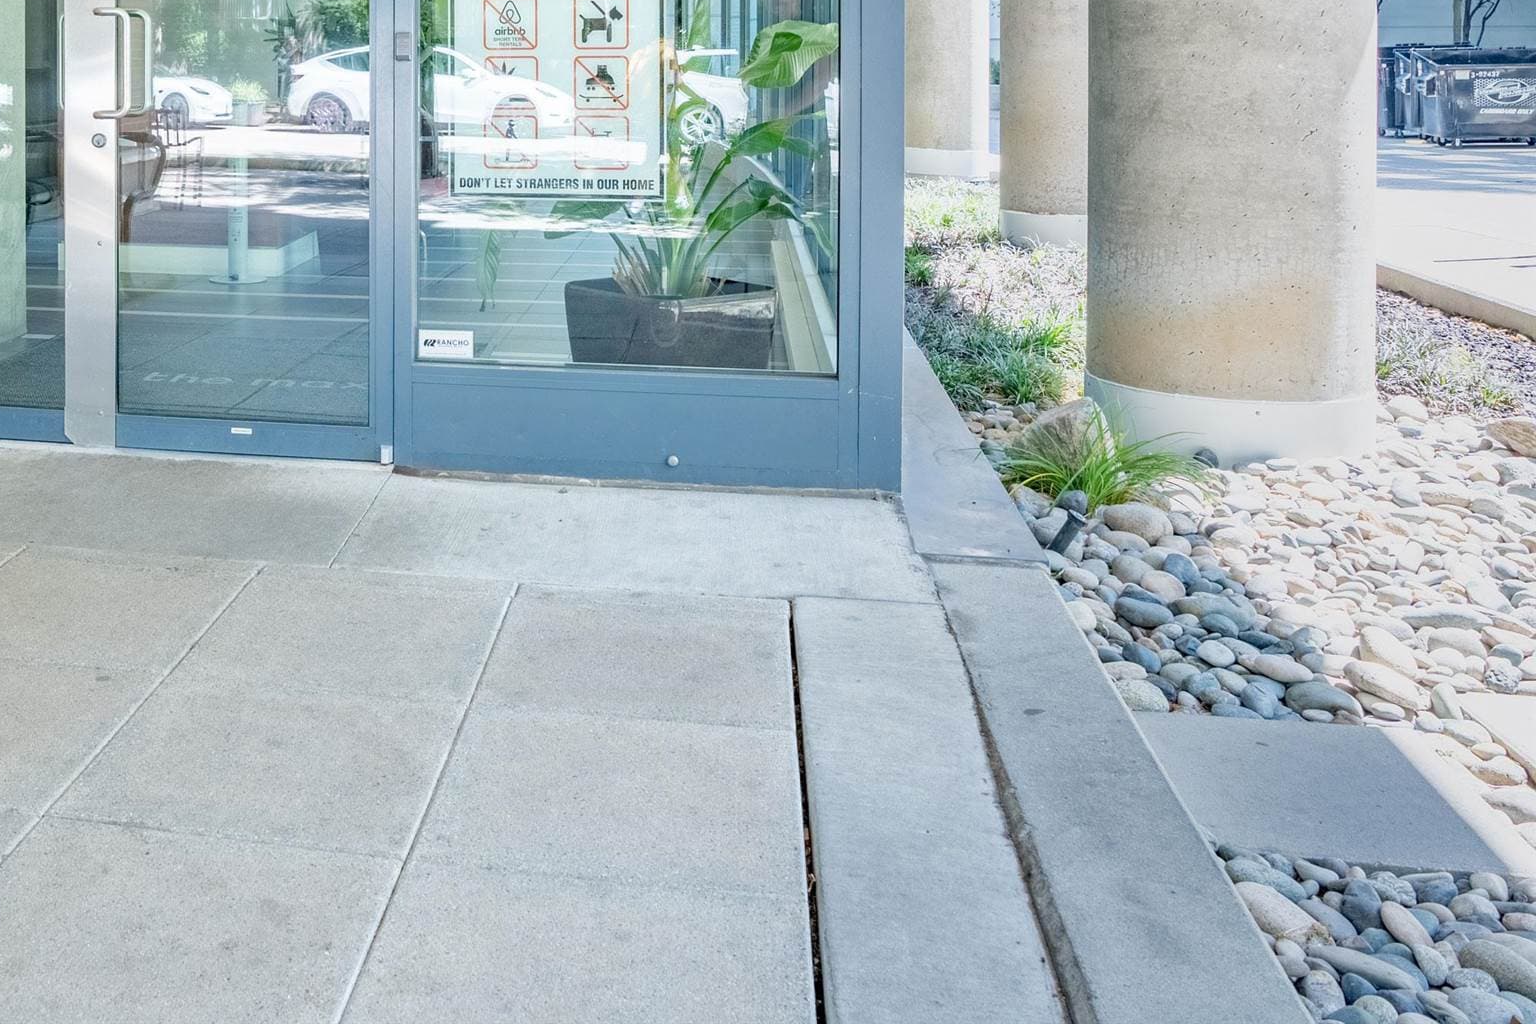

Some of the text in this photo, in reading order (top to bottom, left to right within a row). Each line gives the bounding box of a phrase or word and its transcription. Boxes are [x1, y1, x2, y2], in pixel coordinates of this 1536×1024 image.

[494, 26, 526, 36] airbnb
[459, 177, 655, 190] DON'T LET STRANGERS IN OUR HOME
